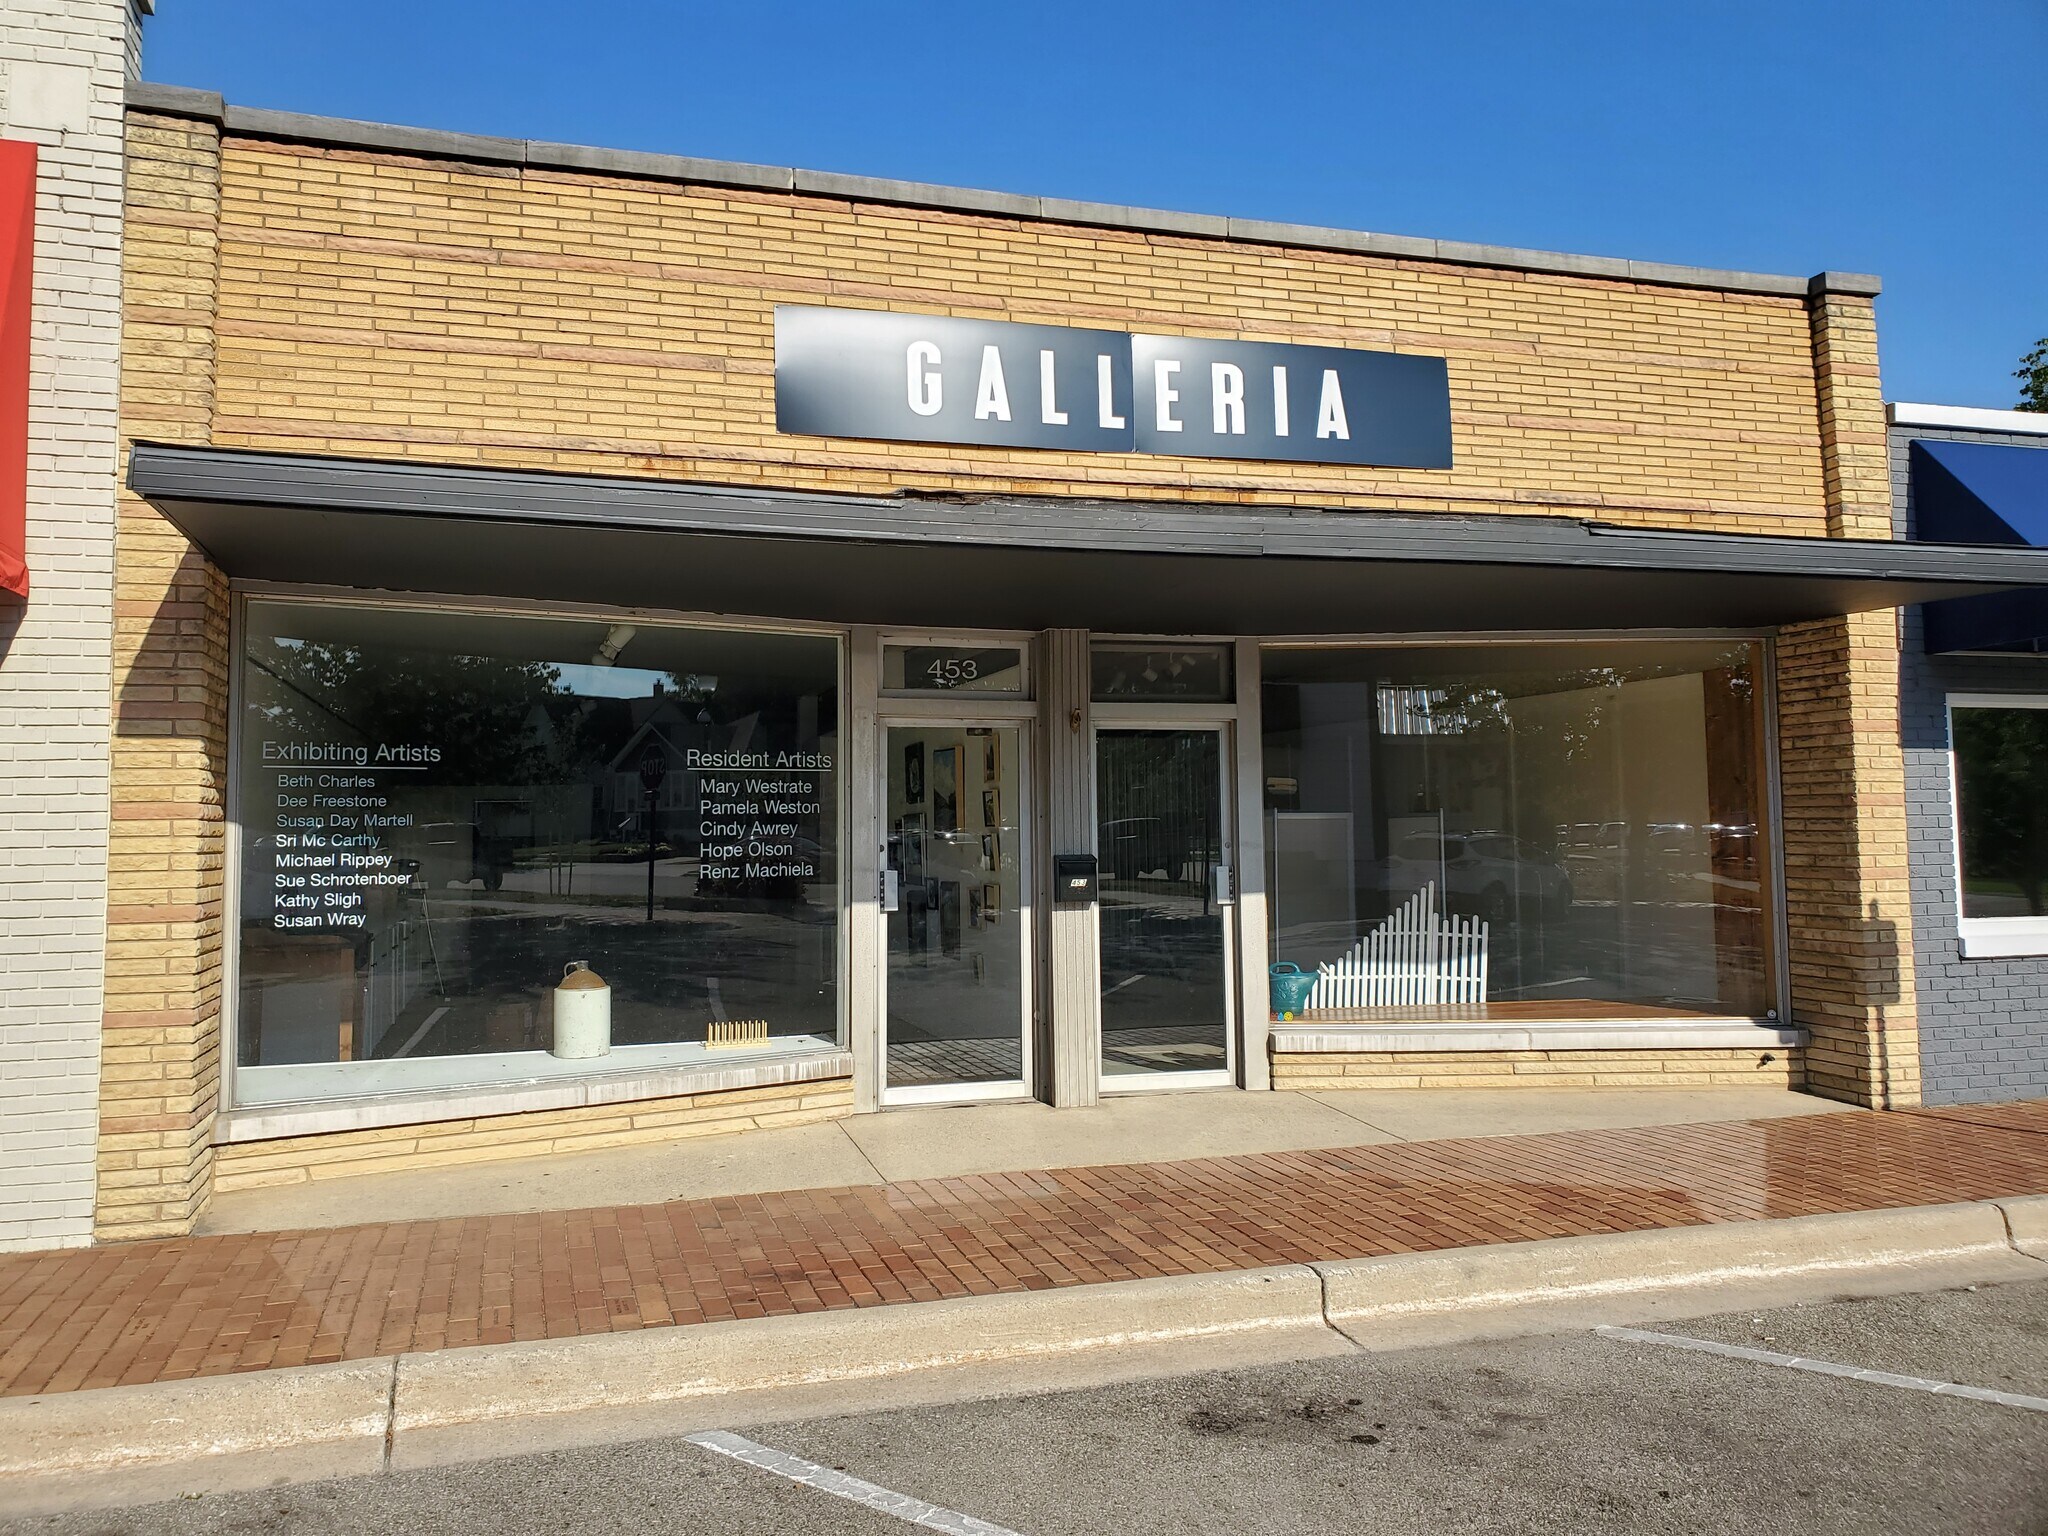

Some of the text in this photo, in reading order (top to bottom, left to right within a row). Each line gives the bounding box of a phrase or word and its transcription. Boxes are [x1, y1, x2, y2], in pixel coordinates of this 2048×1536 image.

[906, 339, 1351, 442] GALLERIA
[926, 658, 978, 679] 453
[262, 741, 441, 765] Exhibiting Artists
[686, 748, 832, 768] Resident Artists
[277, 774, 376, 788] Beth Charles
[700, 778, 812, 797] Mary Westrate
[277, 794, 387, 808] Dee Freestone
[700, 799, 820, 815] Pamela Weston
[276, 813, 413, 830] Susan Day Martell
[700, 820, 799, 840] Cindy Awrey
[275, 833, 381, 849] Sri Mc Carthy
[700, 841, 793, 860] Hope Olson
[275, 853, 393, 868] Michael Rippey
[700, 861, 814, 879] Renz Machiela
[275, 871, 412, 888] Sue Schrotenboer
[275, 892, 362, 910] Kathy Sligh
[274, 912, 367, 928] Susan Wray
